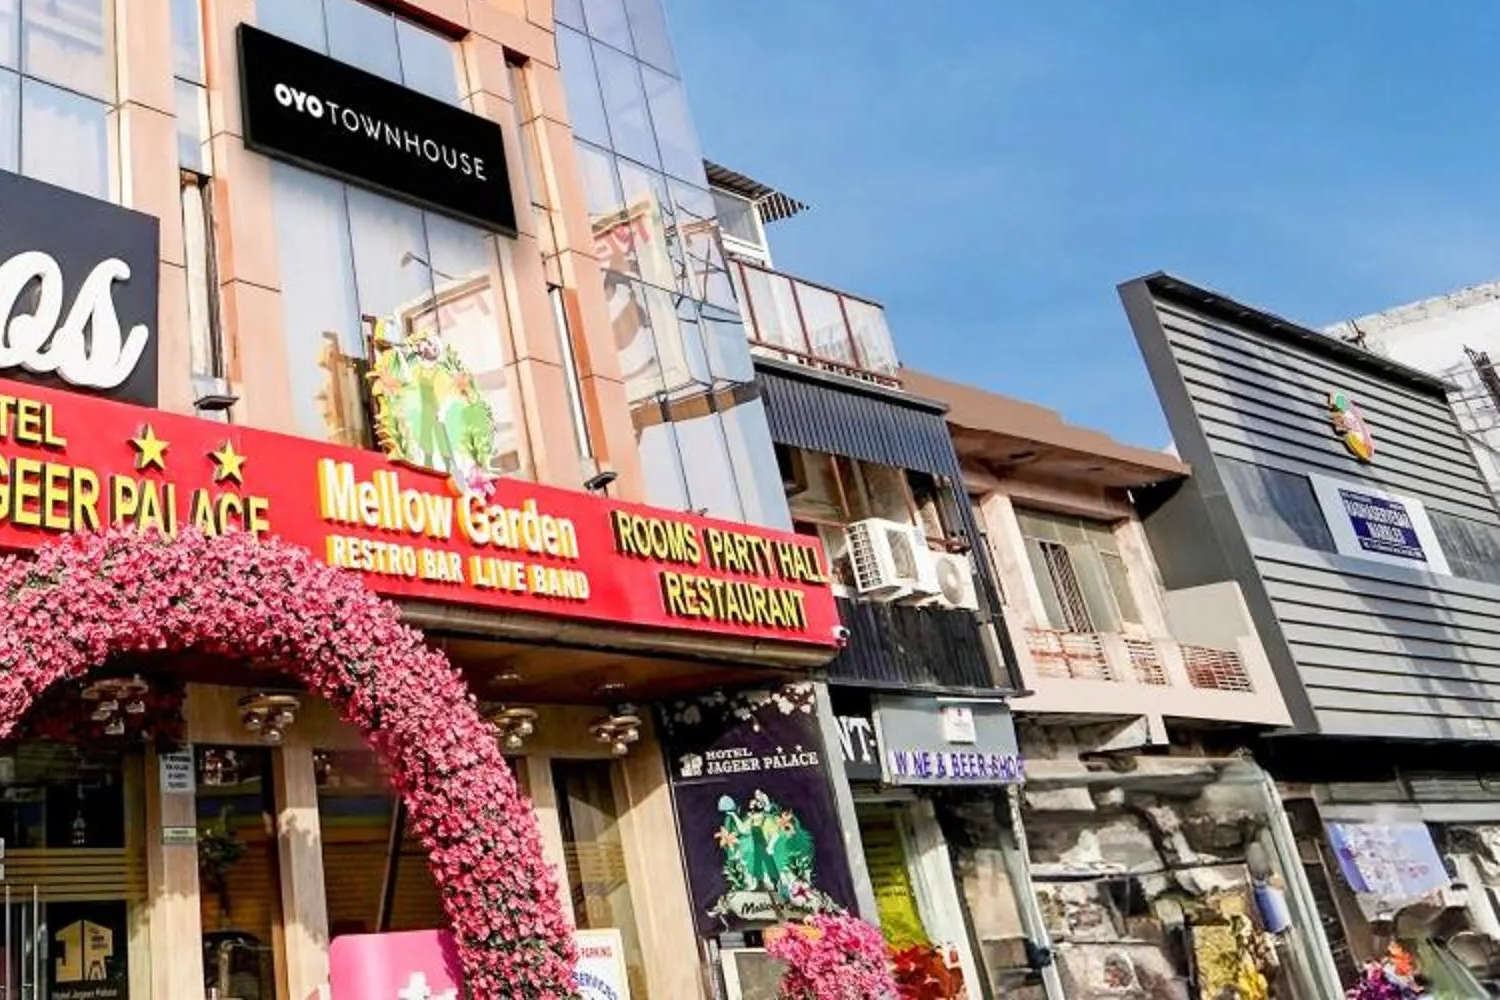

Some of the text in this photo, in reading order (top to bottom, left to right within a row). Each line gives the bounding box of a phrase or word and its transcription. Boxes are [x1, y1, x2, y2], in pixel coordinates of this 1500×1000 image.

[274, 83, 487, 181] OYO TOWNHOUSE
[317, 457, 580, 560] Mellow Garden
[325, 534, 591, 601] RESTRO BAR LIVE BAND
[611, 510, 831, 586] ROOMS PARTY HALL
[658, 570, 809, 632] RESTAURANT
[706, 747, 753, 761] HOTEL
[707, 751, 820, 775] JAGEER PALACE
